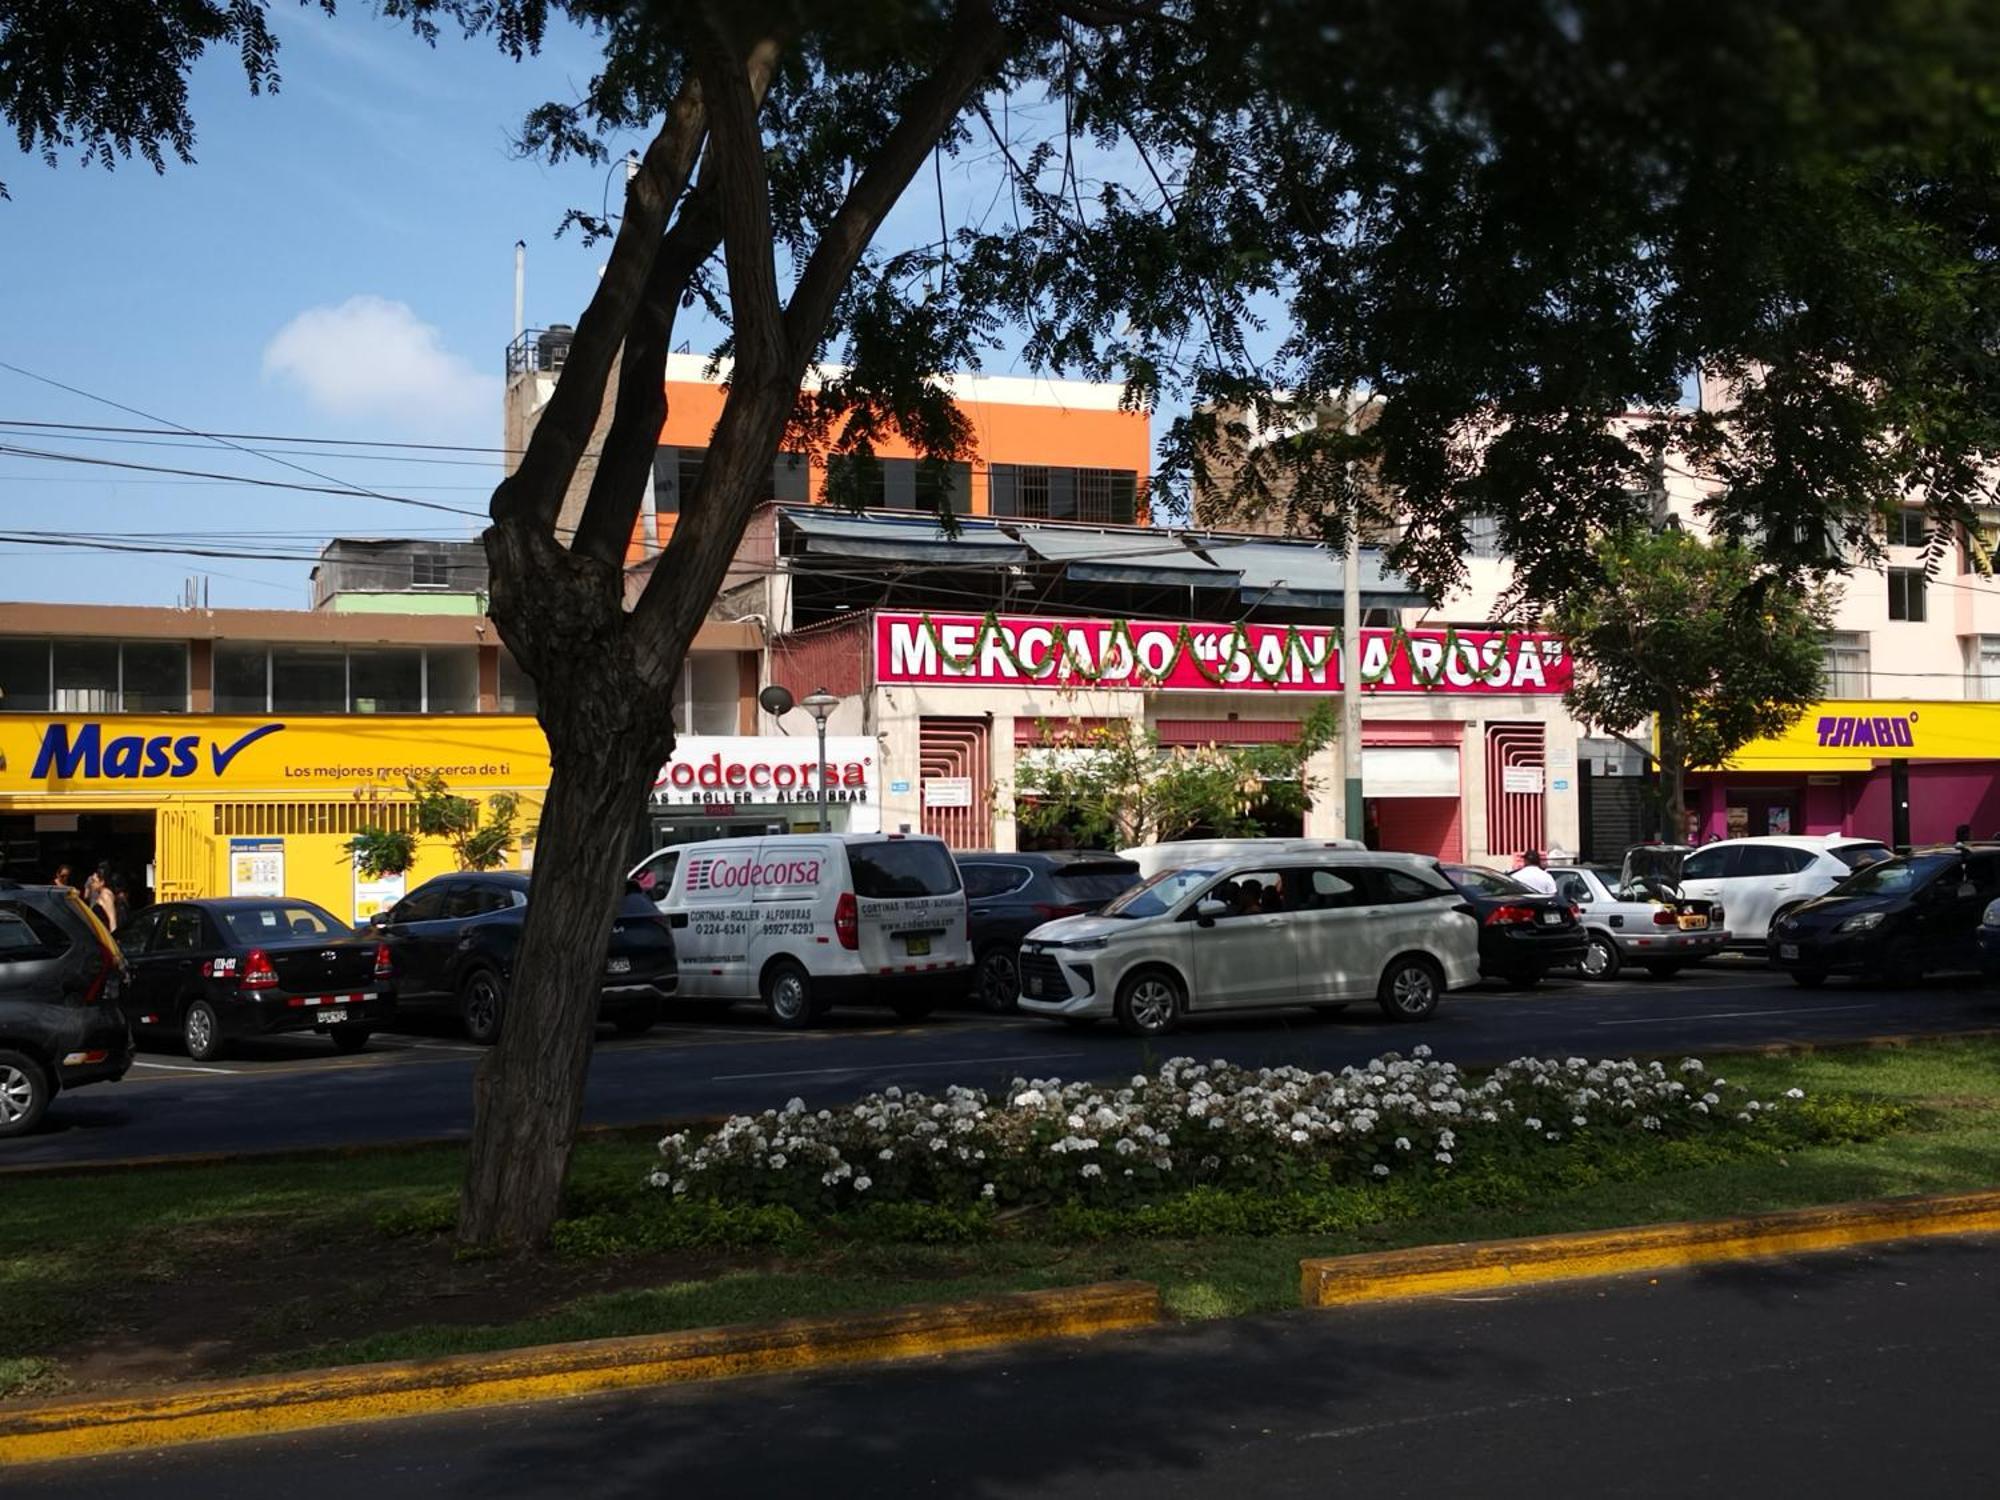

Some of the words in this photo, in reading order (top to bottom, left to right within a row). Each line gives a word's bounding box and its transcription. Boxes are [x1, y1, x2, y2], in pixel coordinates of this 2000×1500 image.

[890, 623, 1173, 681] MERCADO
[1817, 716, 1914, 747] TAMBO
[31, 724, 200, 779] Mass
[285, 765, 311, 777] Los
[314, 764, 373, 779] mejores
[436, 765, 476, 776] cerca
[480, 763, 497, 775] de
[500, 762, 510, 775] ti
[692, 791, 753, 804] ROLLER
[711, 858, 820, 888] Codecorsa
[690, 910, 725, 922] CORTINAS
[730, 909, 760, 921] ROLLER
[766, 908, 811, 920] ALFOMBRAS
